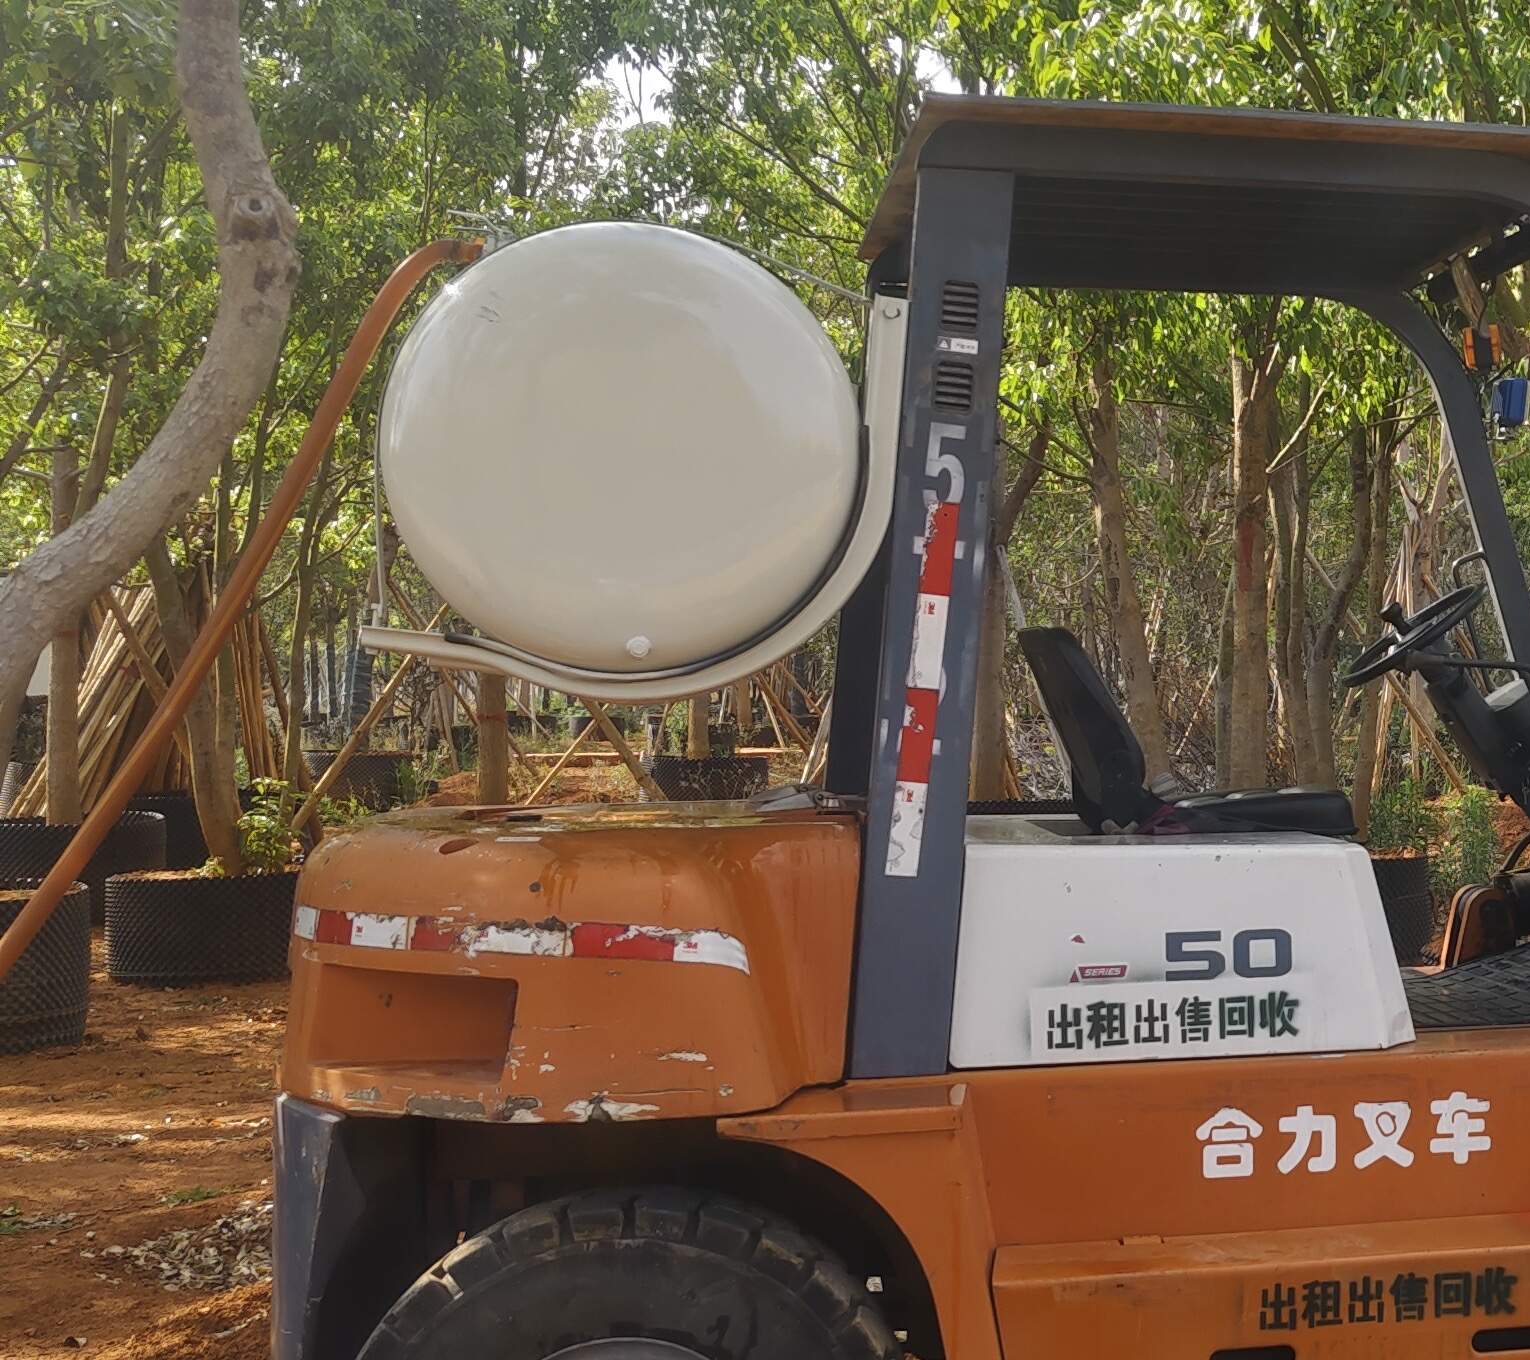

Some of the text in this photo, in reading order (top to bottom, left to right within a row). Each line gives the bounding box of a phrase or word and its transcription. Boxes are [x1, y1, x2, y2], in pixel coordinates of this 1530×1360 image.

[922, 422, 967, 509] 5
[1084, 967, 1121, 976] SERIES
[1165, 928, 1292, 982] 50
[1047, 990, 1300, 1050] 出租出售回收
[1195, 1091, 1492, 1179] 合力叉车
[1260, 1267, 1518, 1330] 出租出售回收
